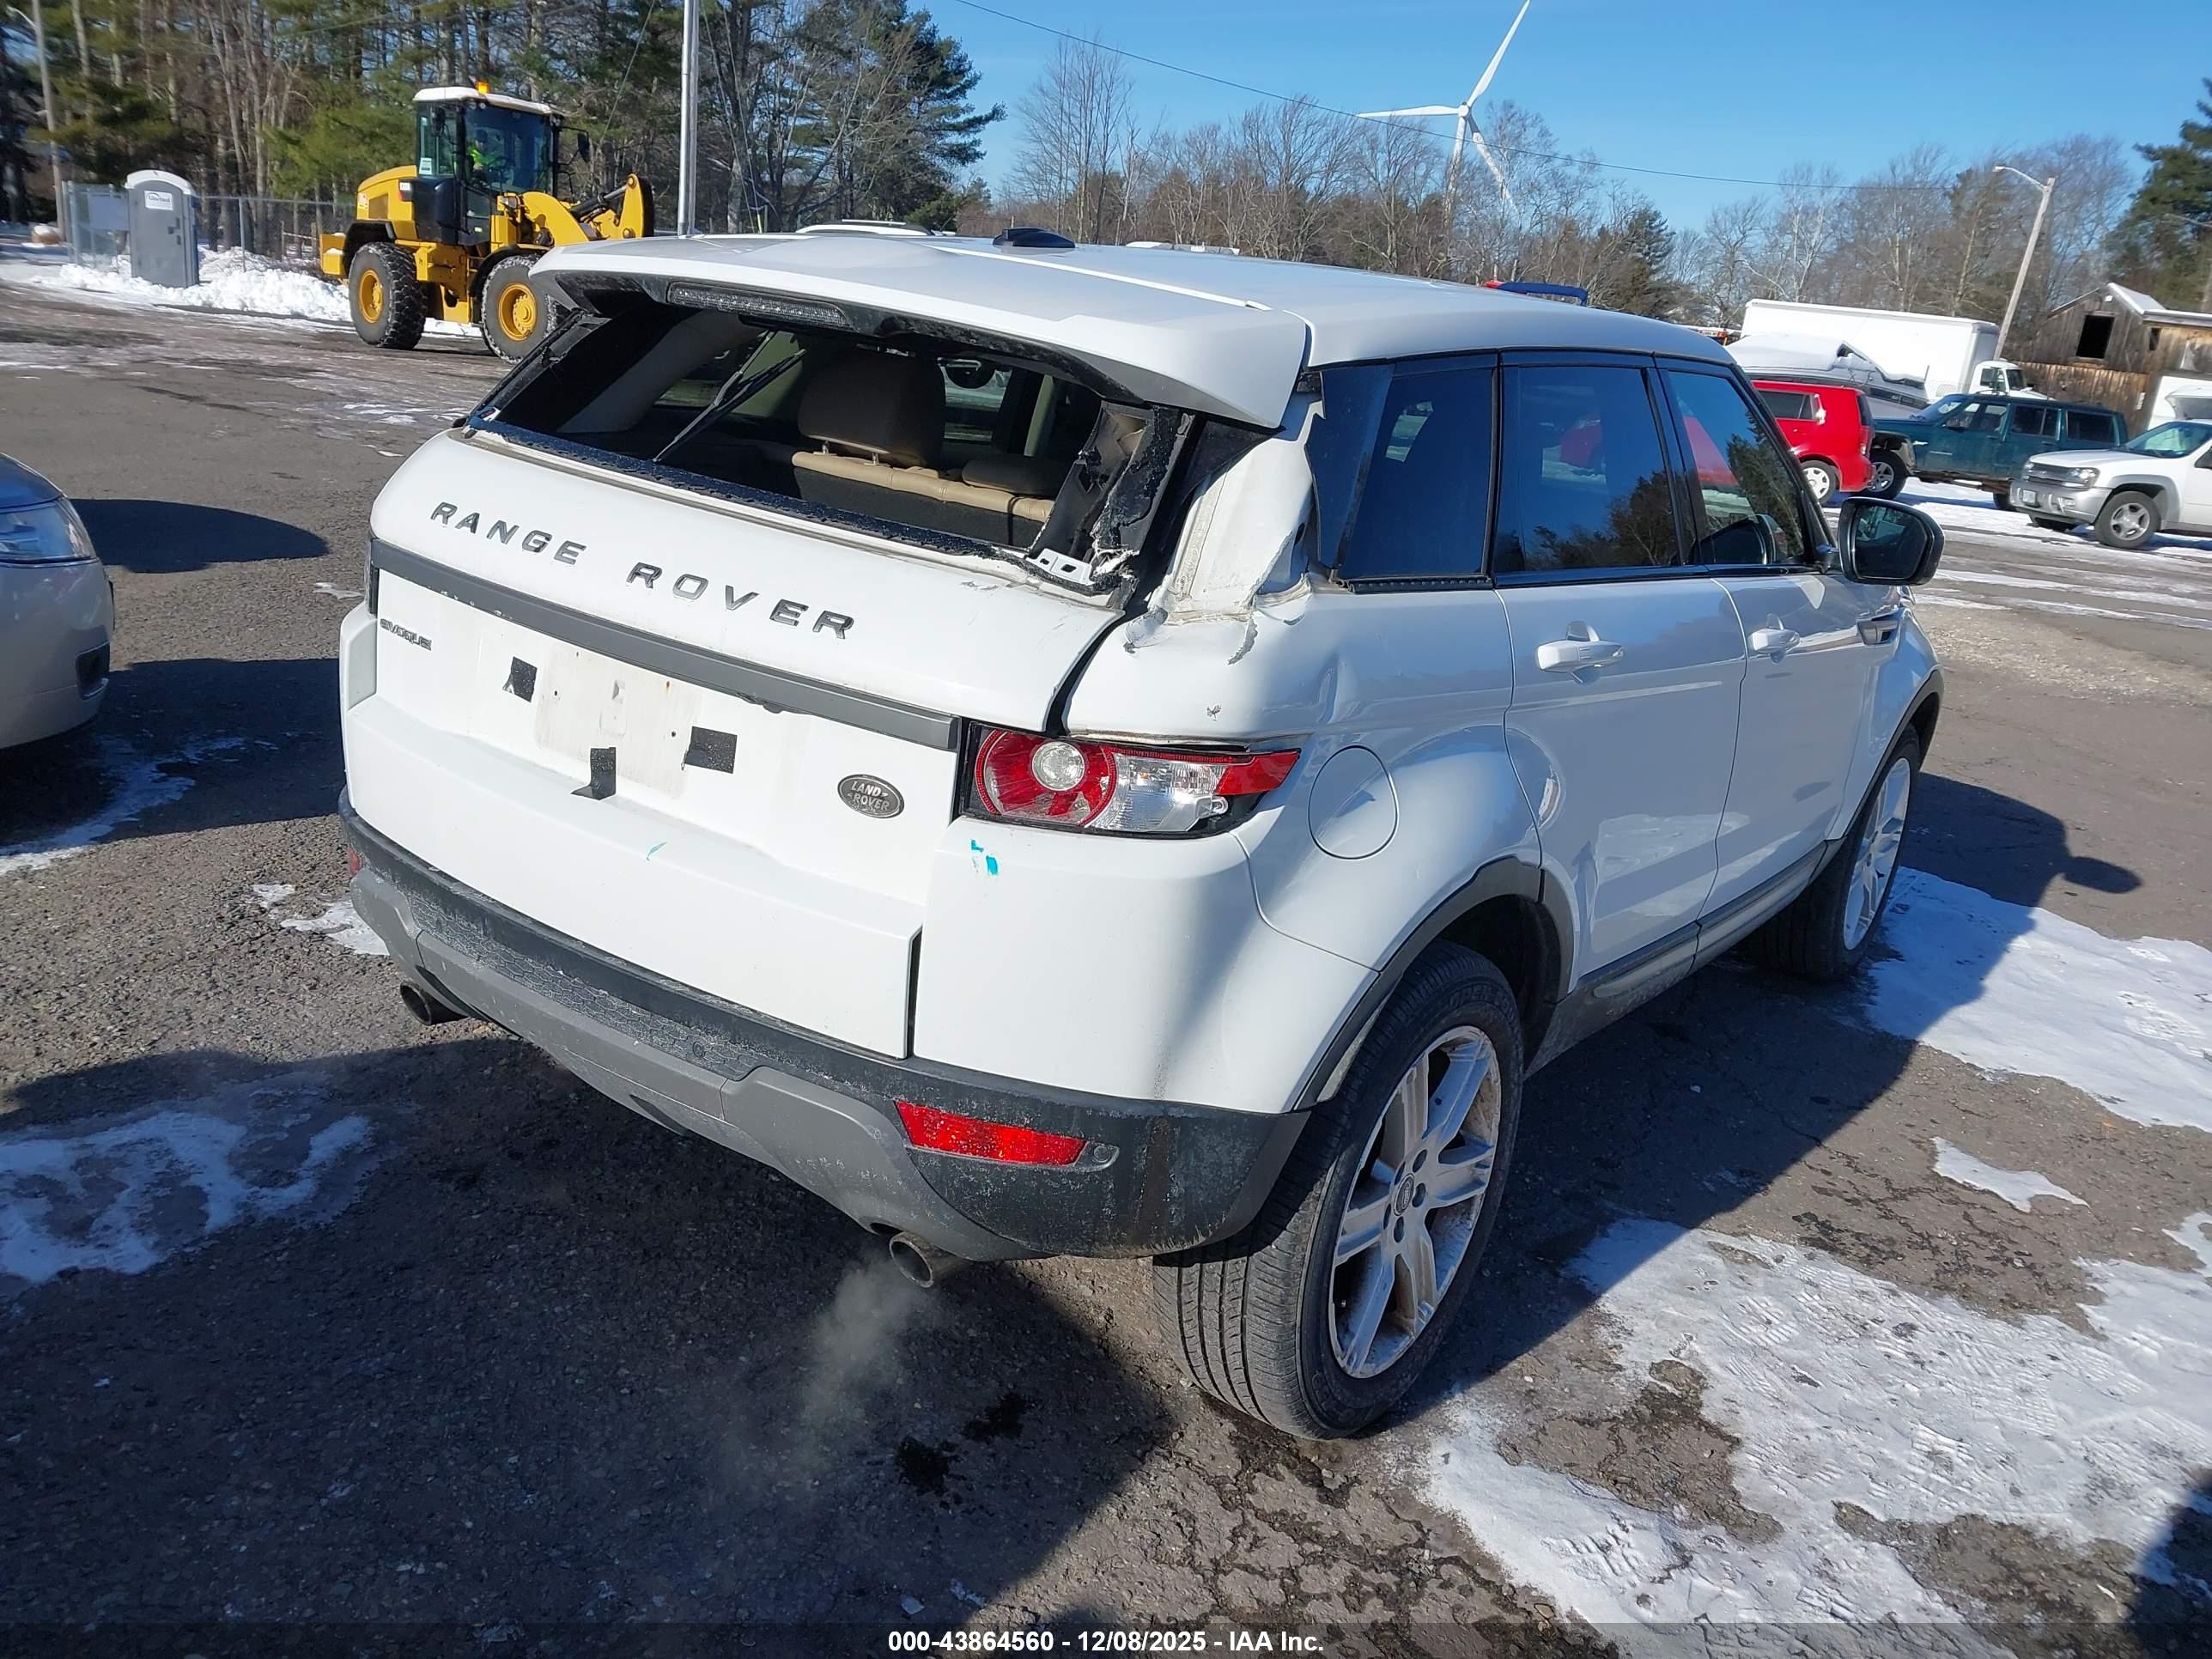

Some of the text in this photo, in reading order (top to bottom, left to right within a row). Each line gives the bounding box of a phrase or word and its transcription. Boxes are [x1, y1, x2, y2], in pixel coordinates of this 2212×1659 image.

[430, 501, 854, 641] RANGE ROVER
[851, 781, 882, 797] LAND
[852, 792, 890, 811] ROVER
